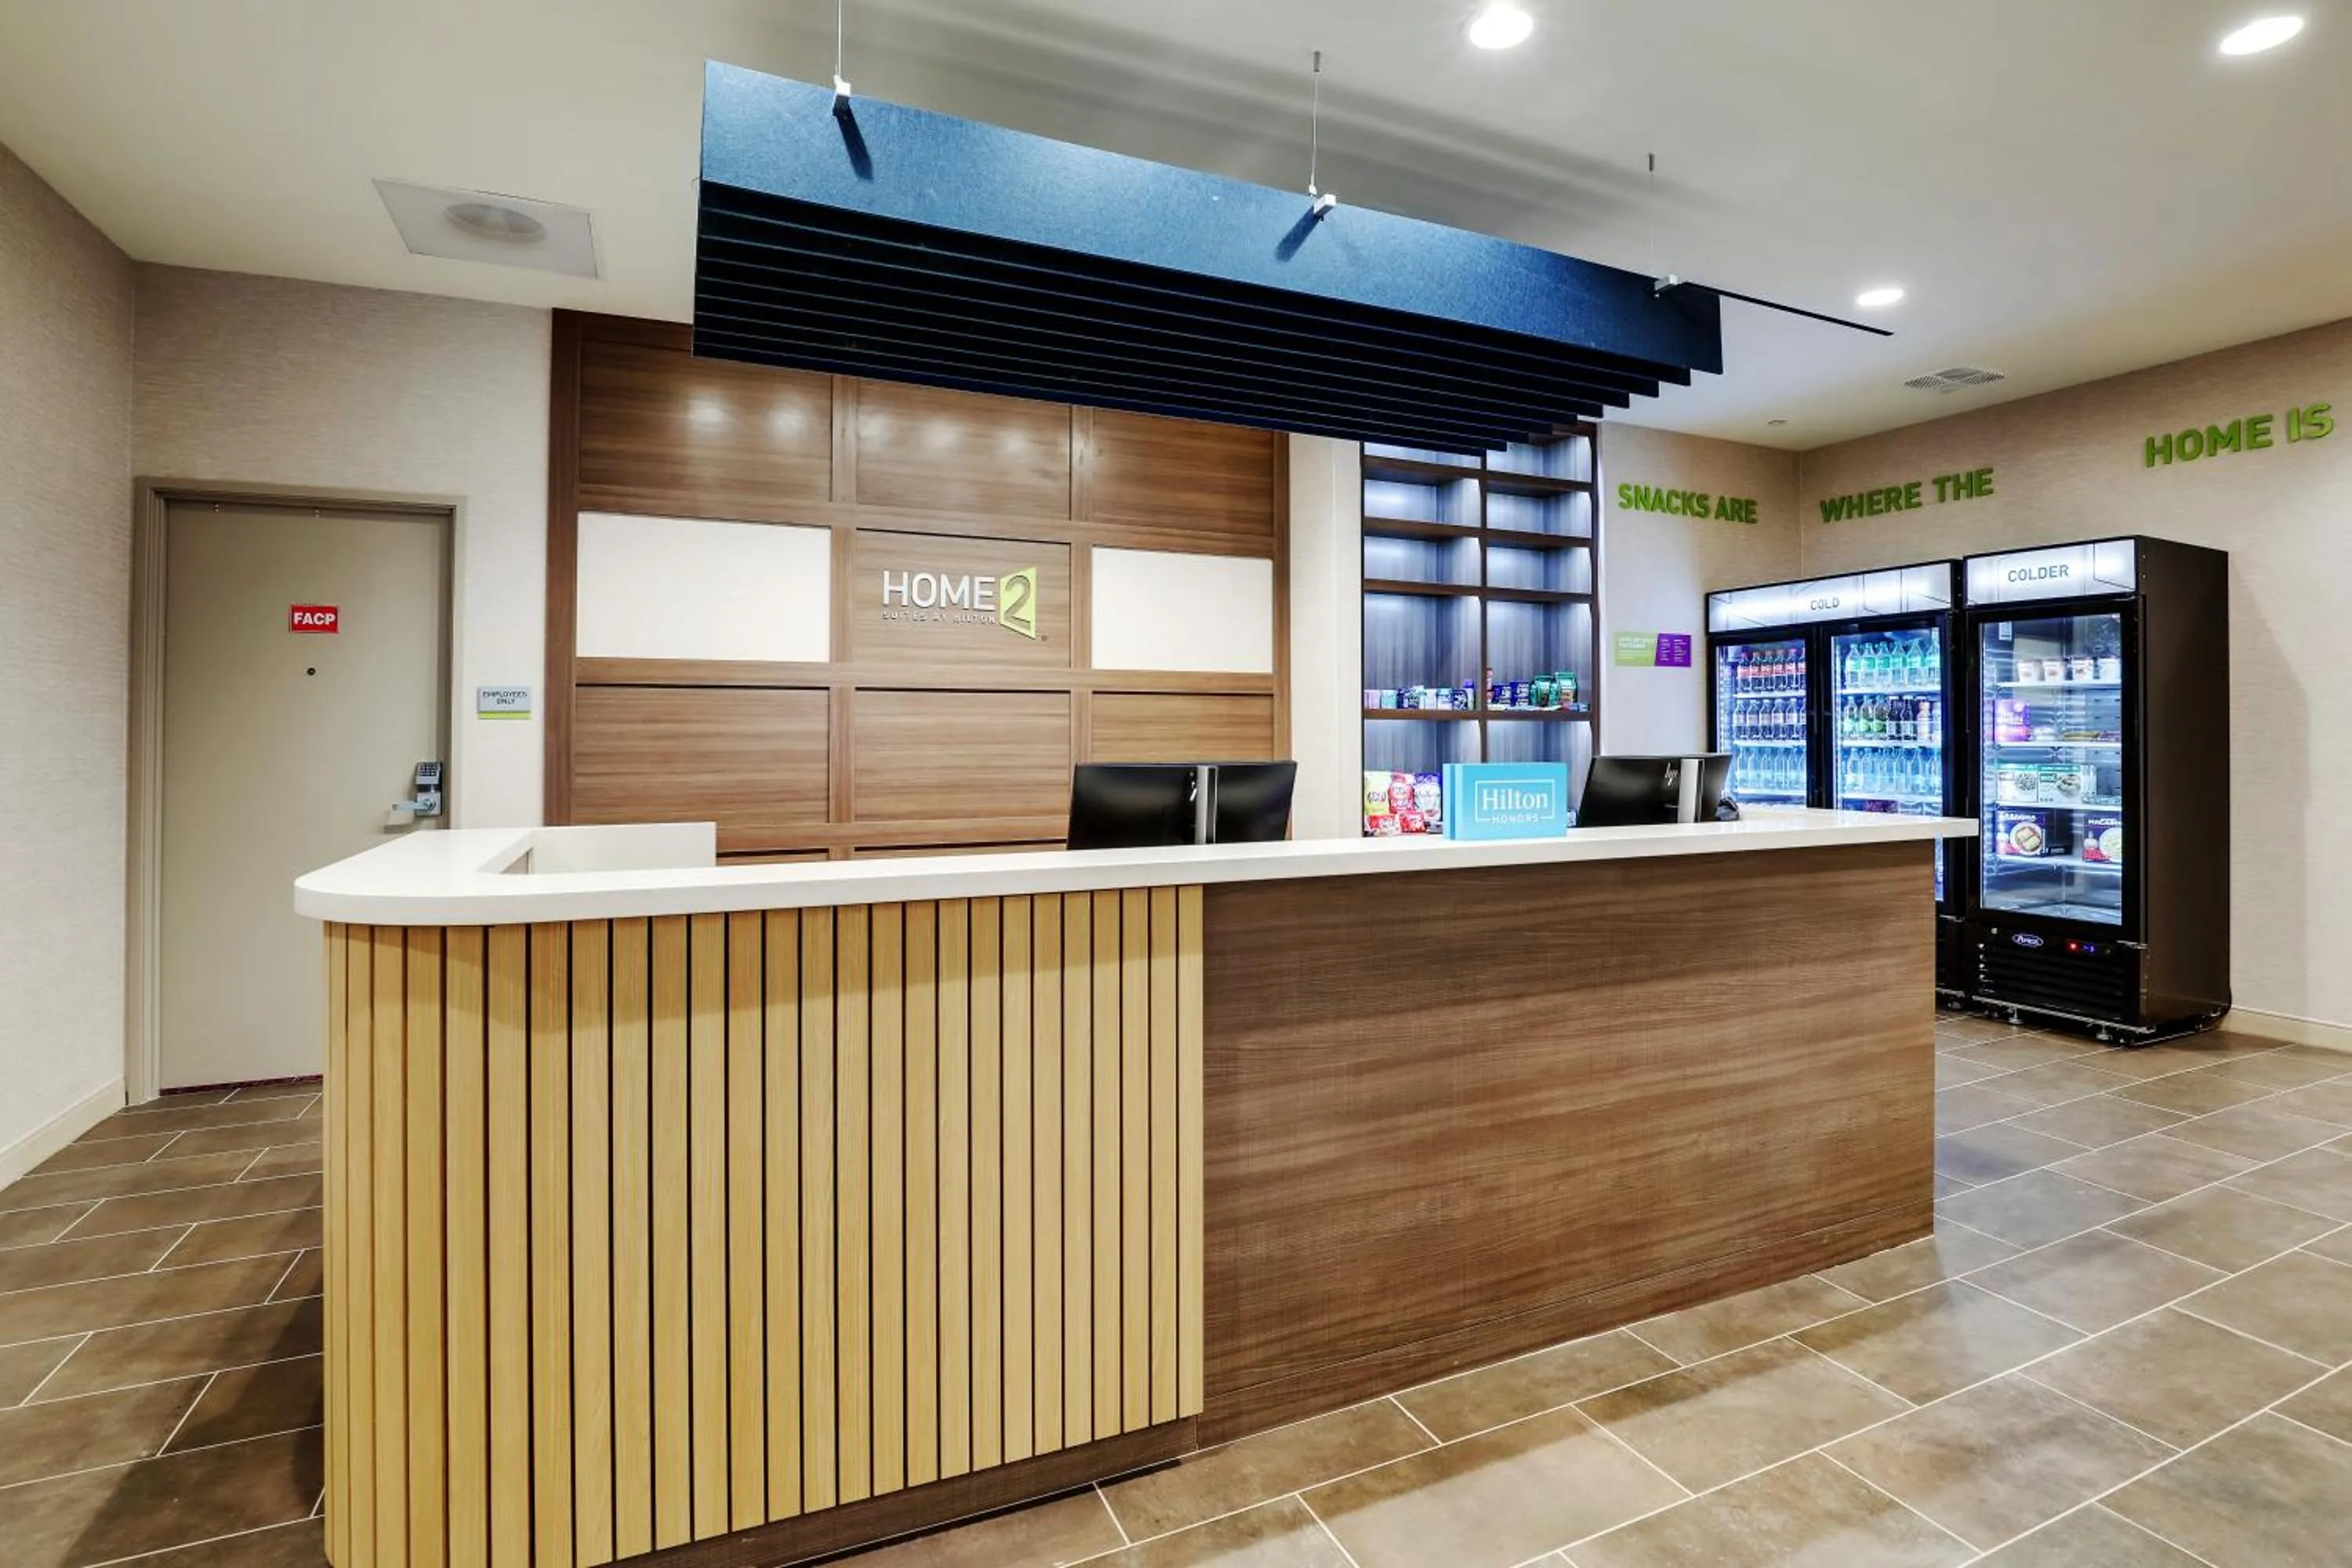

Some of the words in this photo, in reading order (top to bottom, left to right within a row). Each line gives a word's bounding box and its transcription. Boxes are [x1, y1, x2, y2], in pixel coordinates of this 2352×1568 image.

[2145, 413, 2273, 467] HOME
[2286, 403, 2334, 443] IS
[1617, 483, 1710, 518] SNACKS
[1714, 495, 1758, 524] ARE
[1820, 481, 1922, 523] WHERE
[1932, 467, 1994, 503] THE
[2008, 564, 2069, 583] COLDER
[1810, 597, 1840, 611] COLD
[294, 612, 336, 625] FACP
[1482, 787, 1548, 811] Hilton
[1492, 813, 1539, 824] HONORS
